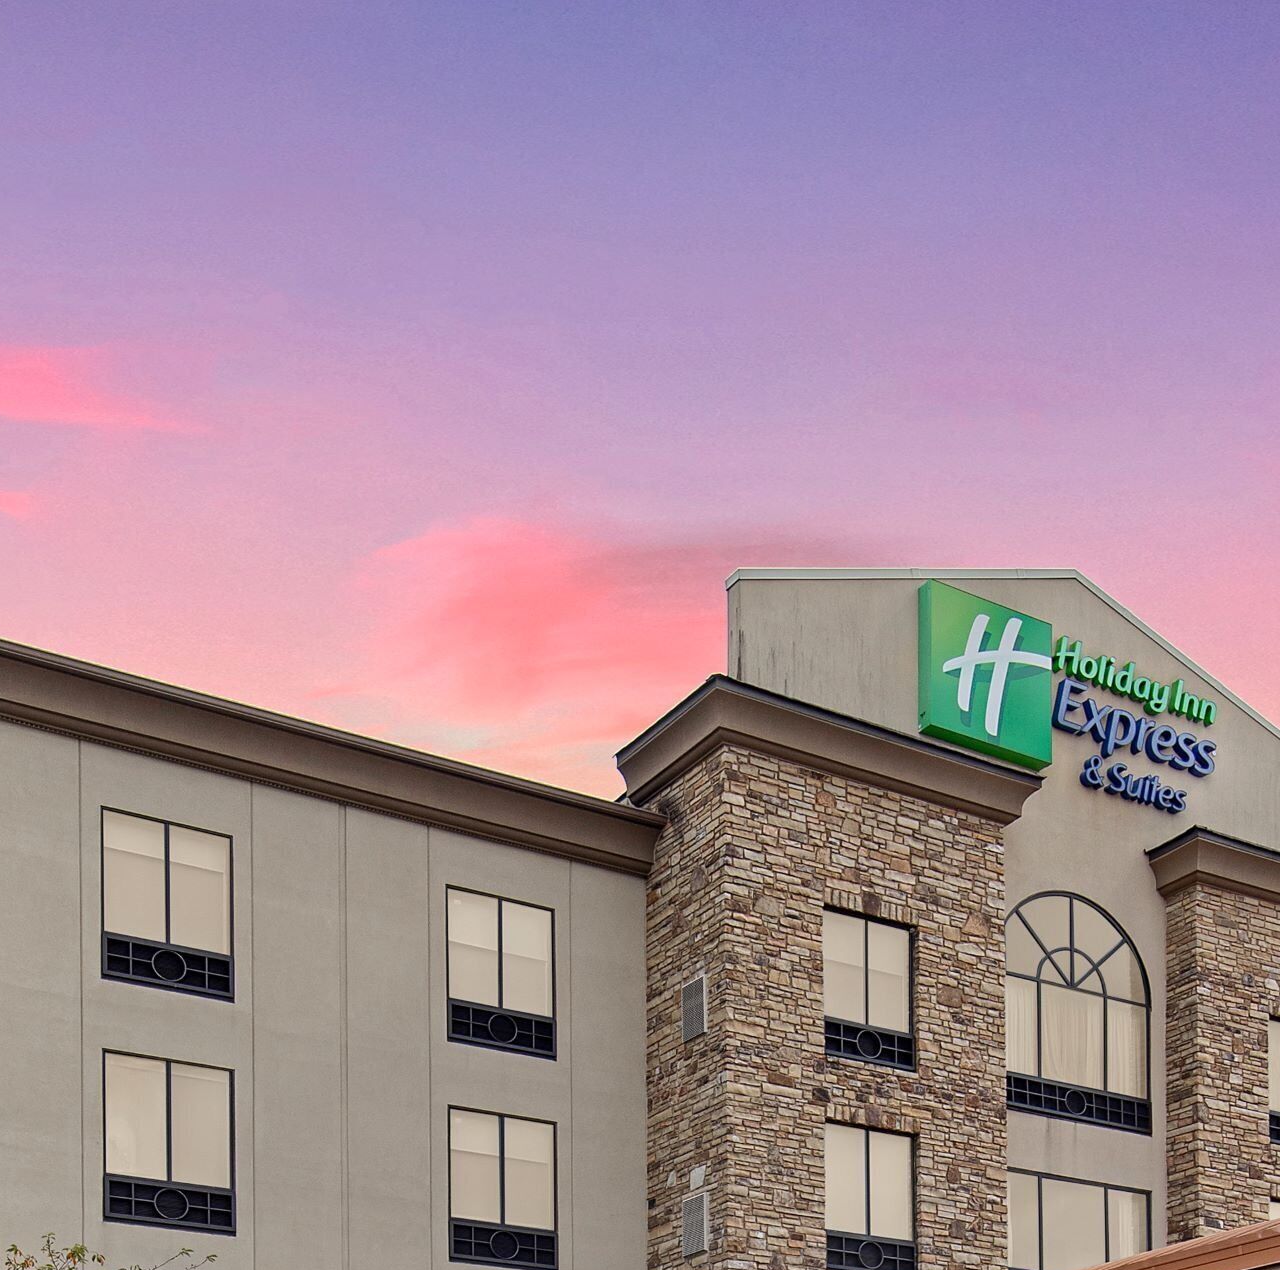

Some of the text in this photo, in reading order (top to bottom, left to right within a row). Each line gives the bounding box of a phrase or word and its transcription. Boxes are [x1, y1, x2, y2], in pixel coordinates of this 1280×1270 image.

[1052, 635, 1217, 727] Holiday Inn
[1052, 678, 1217, 777] Express
[1080, 755, 1187, 814] & Suites
